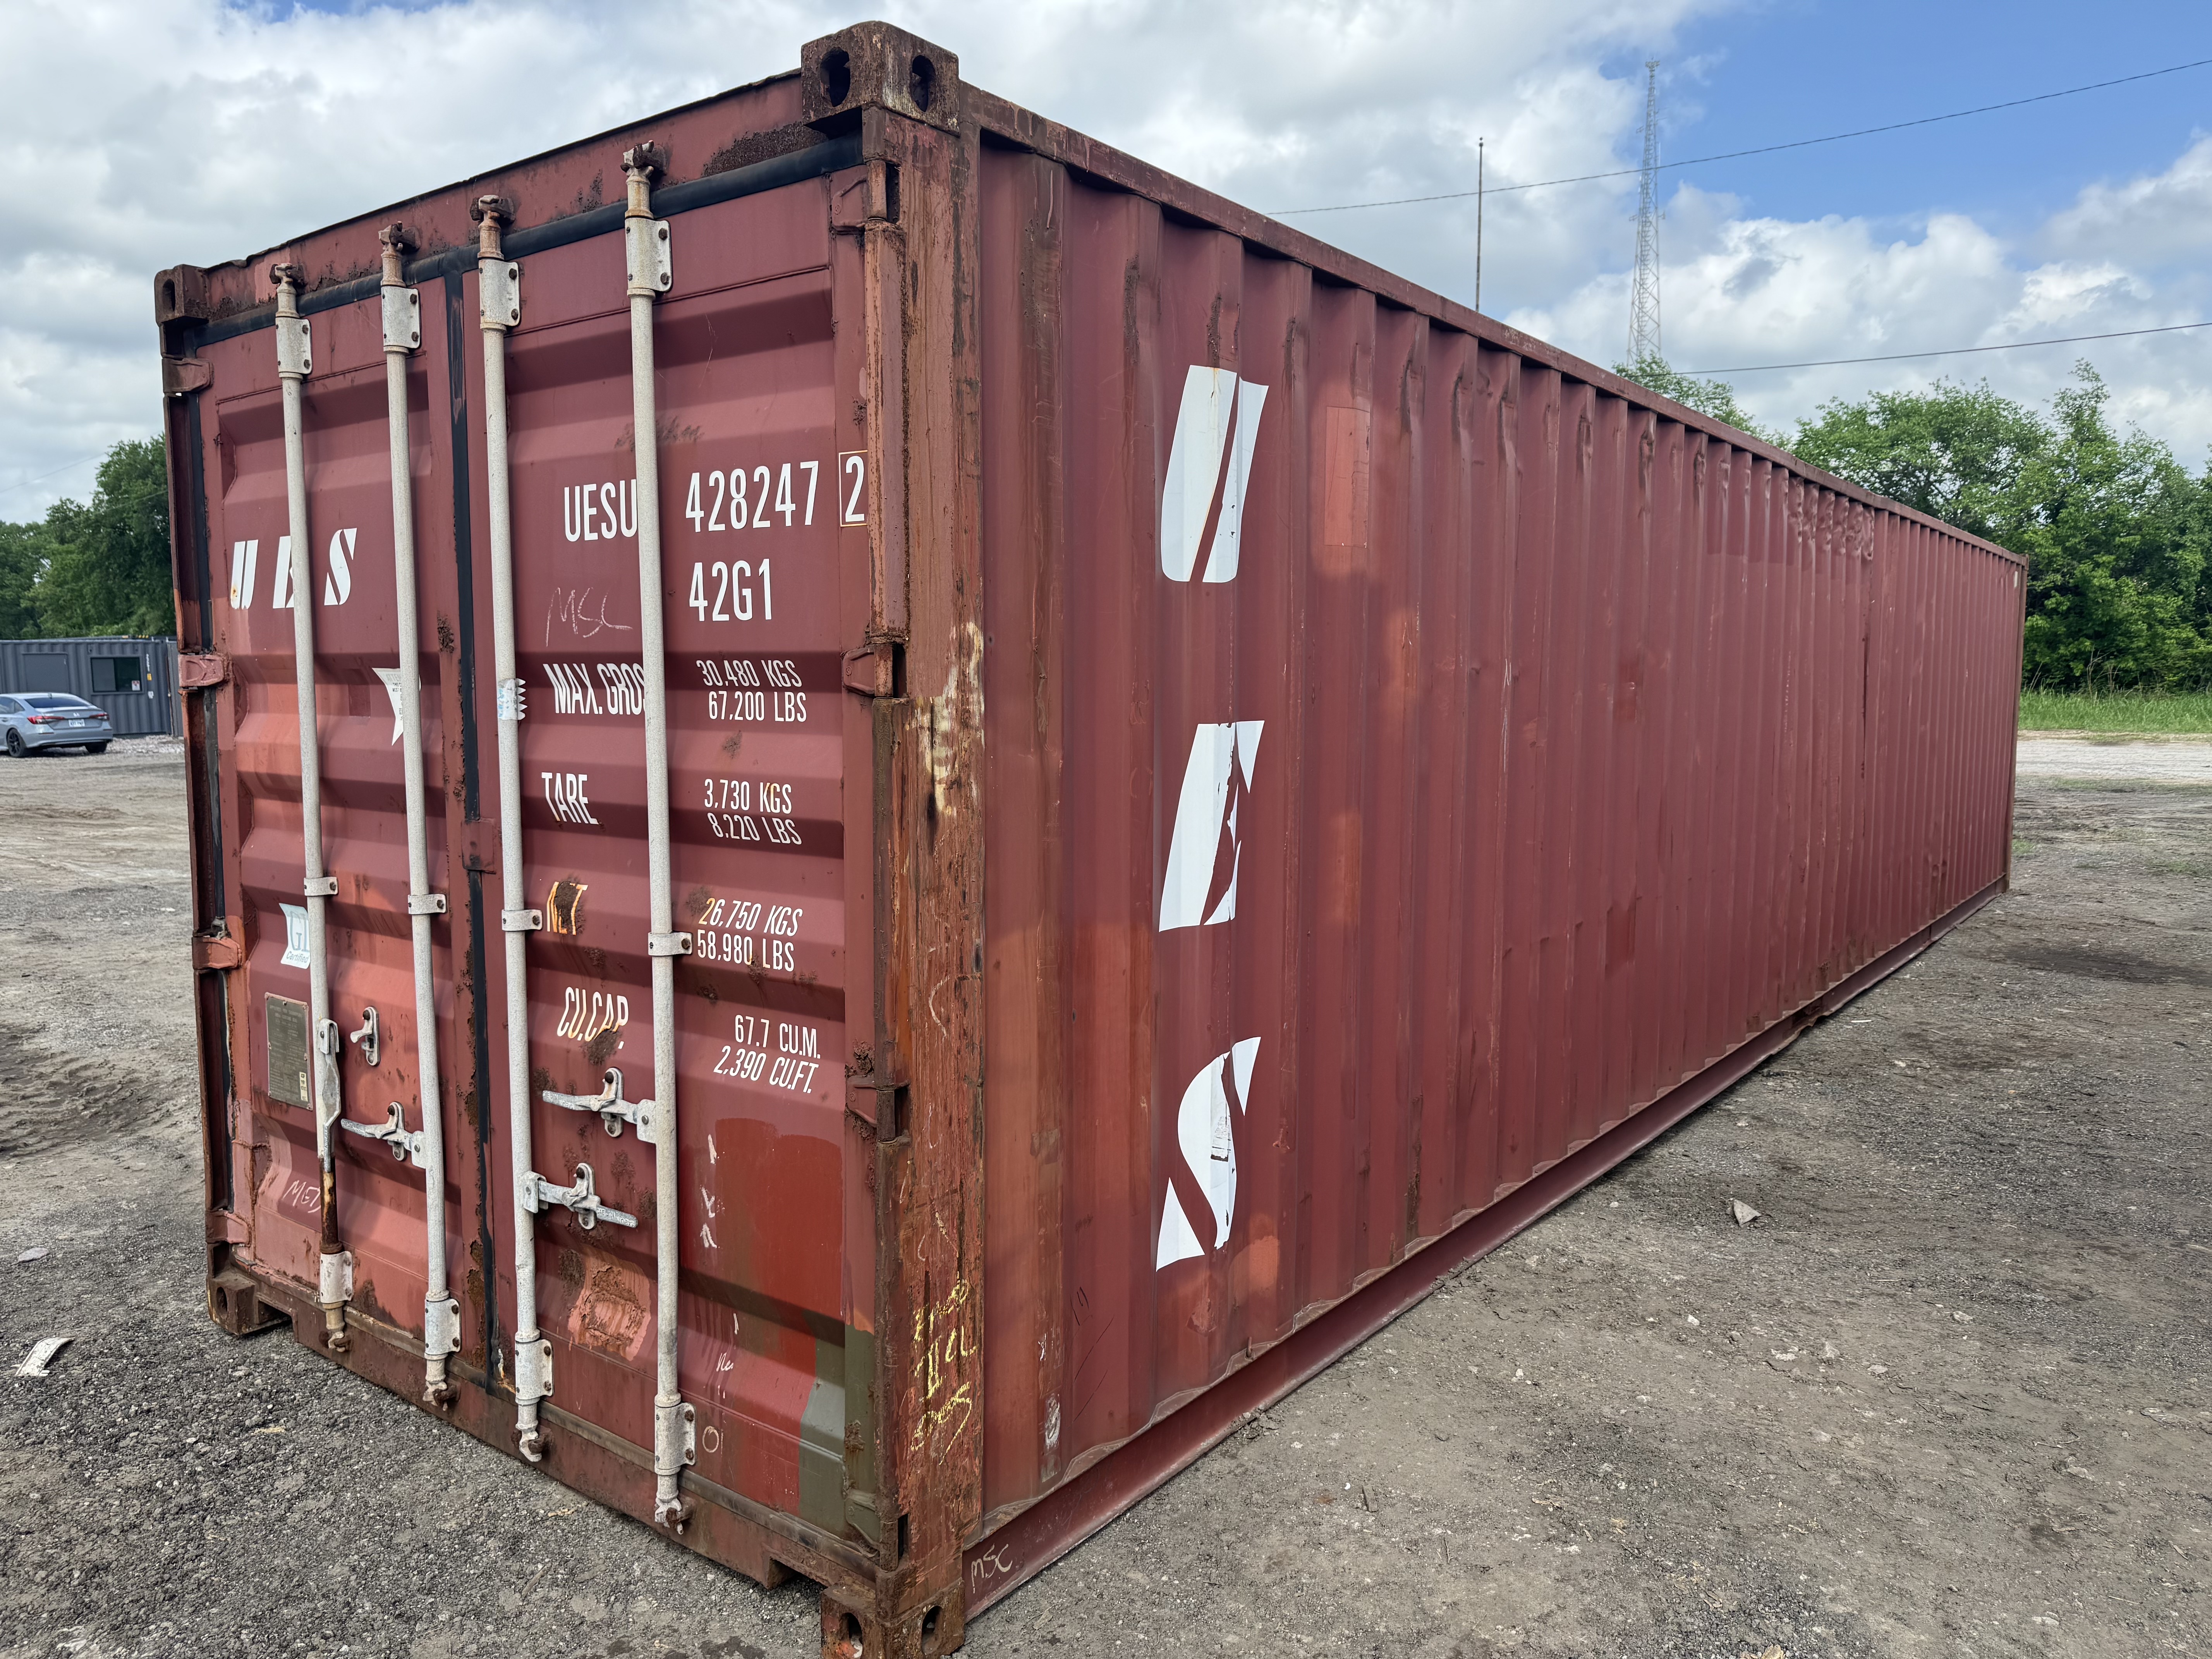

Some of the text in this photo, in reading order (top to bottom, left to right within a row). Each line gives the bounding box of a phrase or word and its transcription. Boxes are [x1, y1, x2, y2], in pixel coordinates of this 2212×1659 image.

[564, 456, 865, 542] UESU 428247 2
[689, 558, 772, 622] 42G1
[543, 663, 603, 714] MAX.
[761, 660, 802, 687] KGS
[709, 690, 807, 722] 67,200 LBS
[542, 772, 792, 825] TARE 3,730 KGS
[761, 817, 802, 845] LBS
[698, 898, 762, 931] 26,750
[763, 905, 803, 936] KGS
[287, 951, 309, 963] Certified
[697, 929, 794, 972] 58,980 LBS
[735, 1015, 769, 1048] 67.7
[780, 1023, 821, 1059] CU.M.
[713, 1045, 819, 1094] 2,390 CU.FT.
[971, 1544, 1012, 1593] MSC
